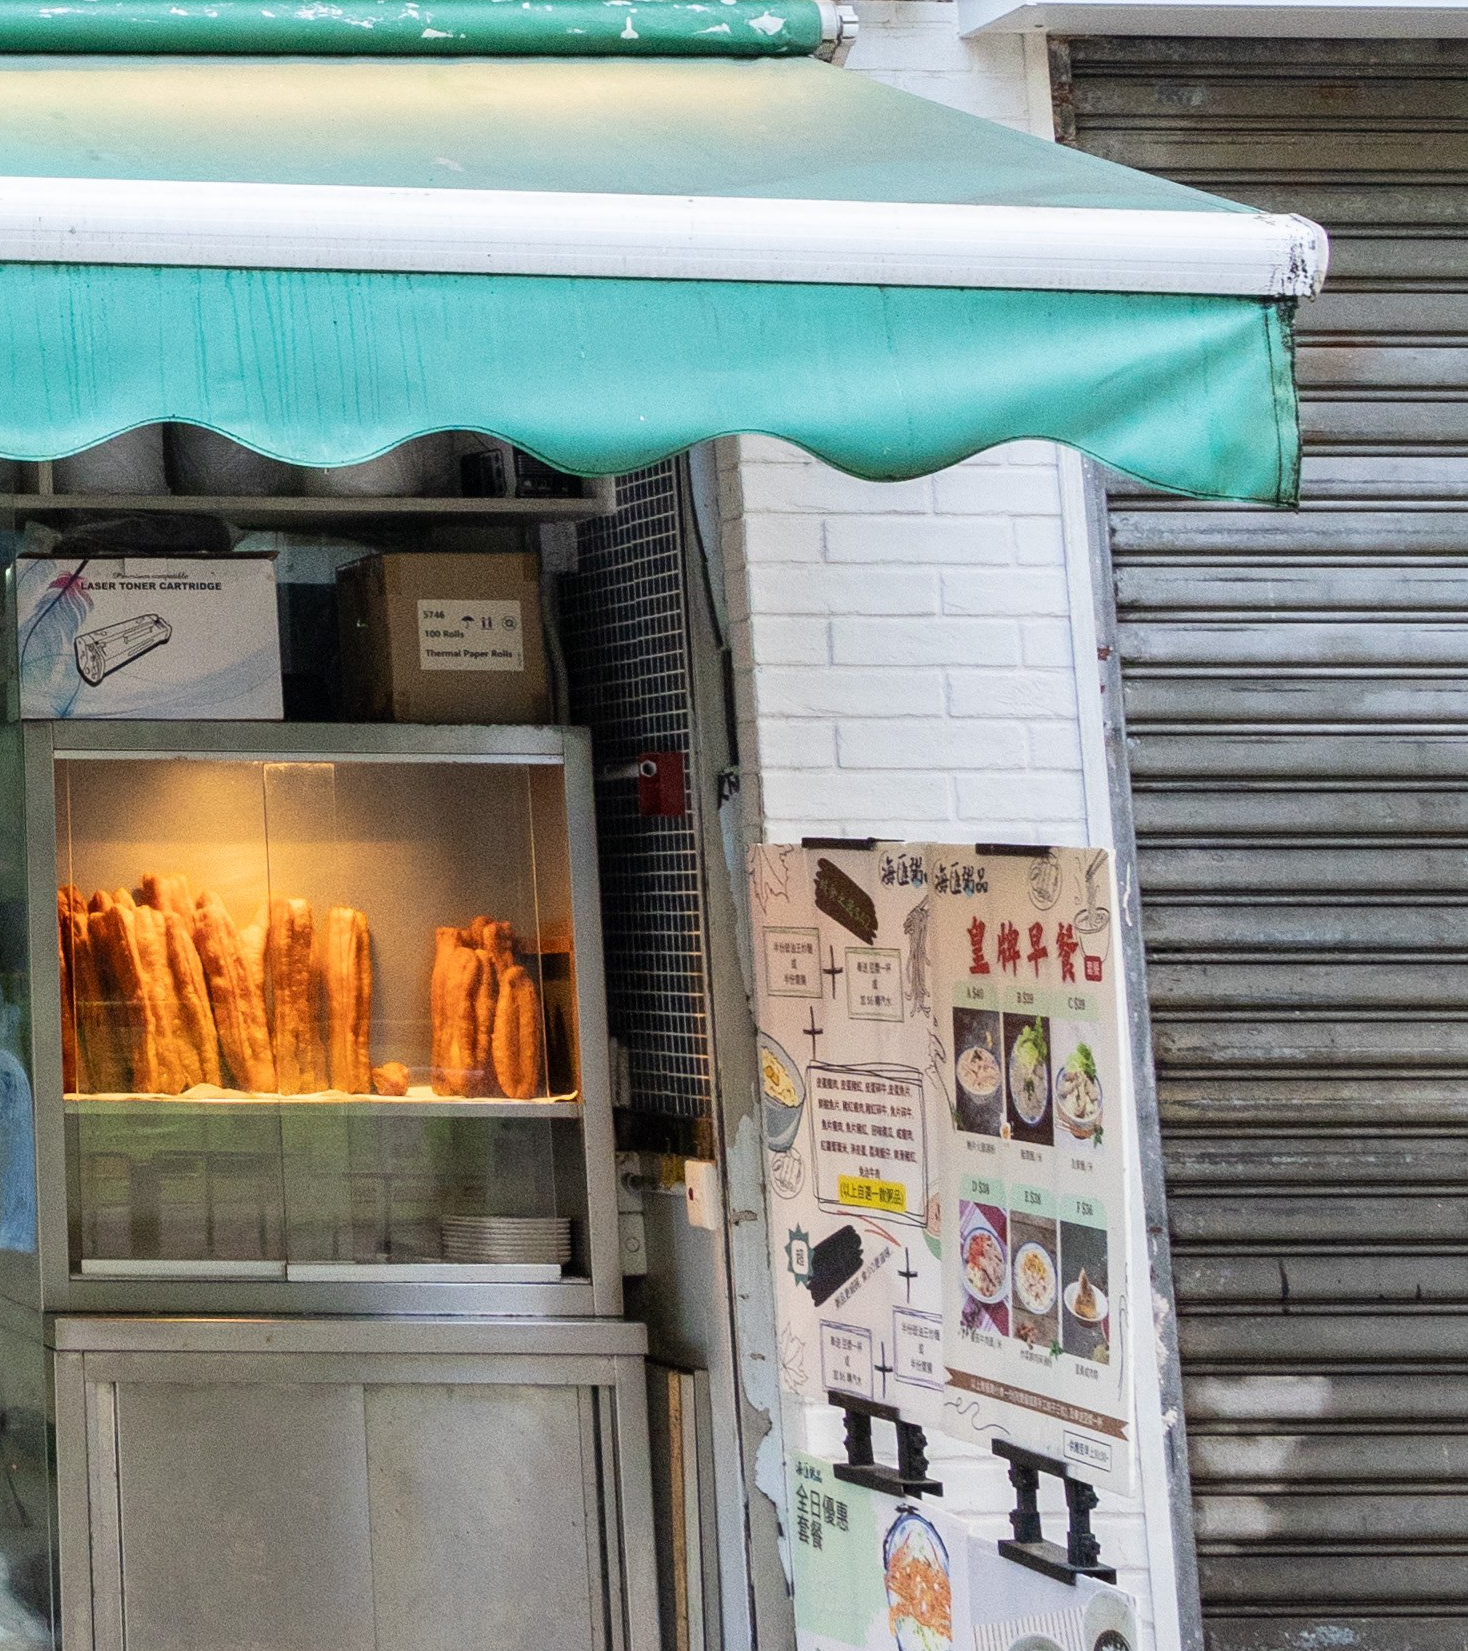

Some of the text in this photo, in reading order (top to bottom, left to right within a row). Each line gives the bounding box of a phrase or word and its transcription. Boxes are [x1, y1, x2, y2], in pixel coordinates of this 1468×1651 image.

[81, 582, 222, 590] LASER TONER CARTRIDGE
[424, 611, 445, 619] 5746
[426, 649, 461, 657] Thermal
[464, 650, 488, 658] Paper
[967, 916, 1078, 983] 皇牌早餐
